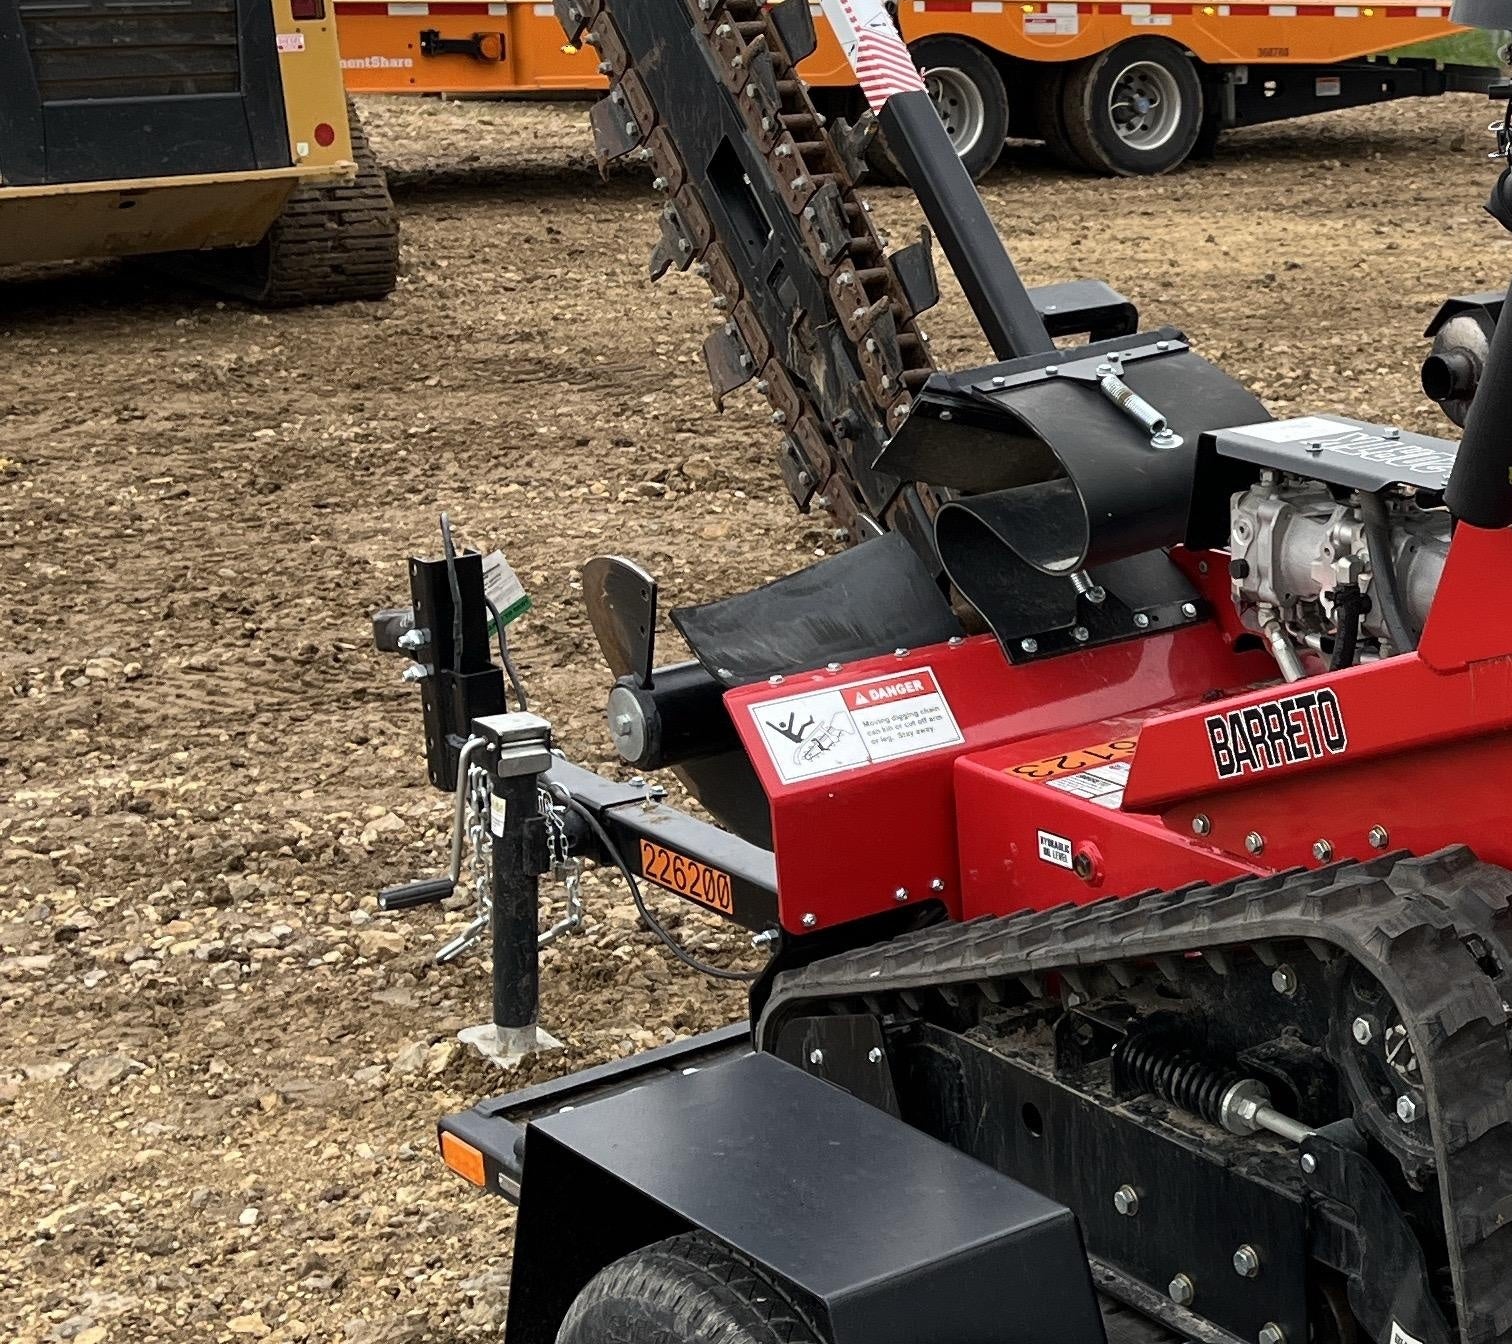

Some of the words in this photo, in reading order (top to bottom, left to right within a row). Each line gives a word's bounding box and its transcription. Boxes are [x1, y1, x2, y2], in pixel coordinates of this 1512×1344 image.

[869, 679, 924, 701] DANGER
[862, 717, 890, 728] Moving
[891, 711, 919, 722] digging
[920, 706, 940, 715] chain
[904, 720, 916, 728] cut
[917, 717, 927, 725] off
[897, 730, 914, 739] Stay
[1205, 687, 1347, 779] BARRETO
[1012, 740, 1137, 778] 6123
[643, 842, 730, 910] 226200
